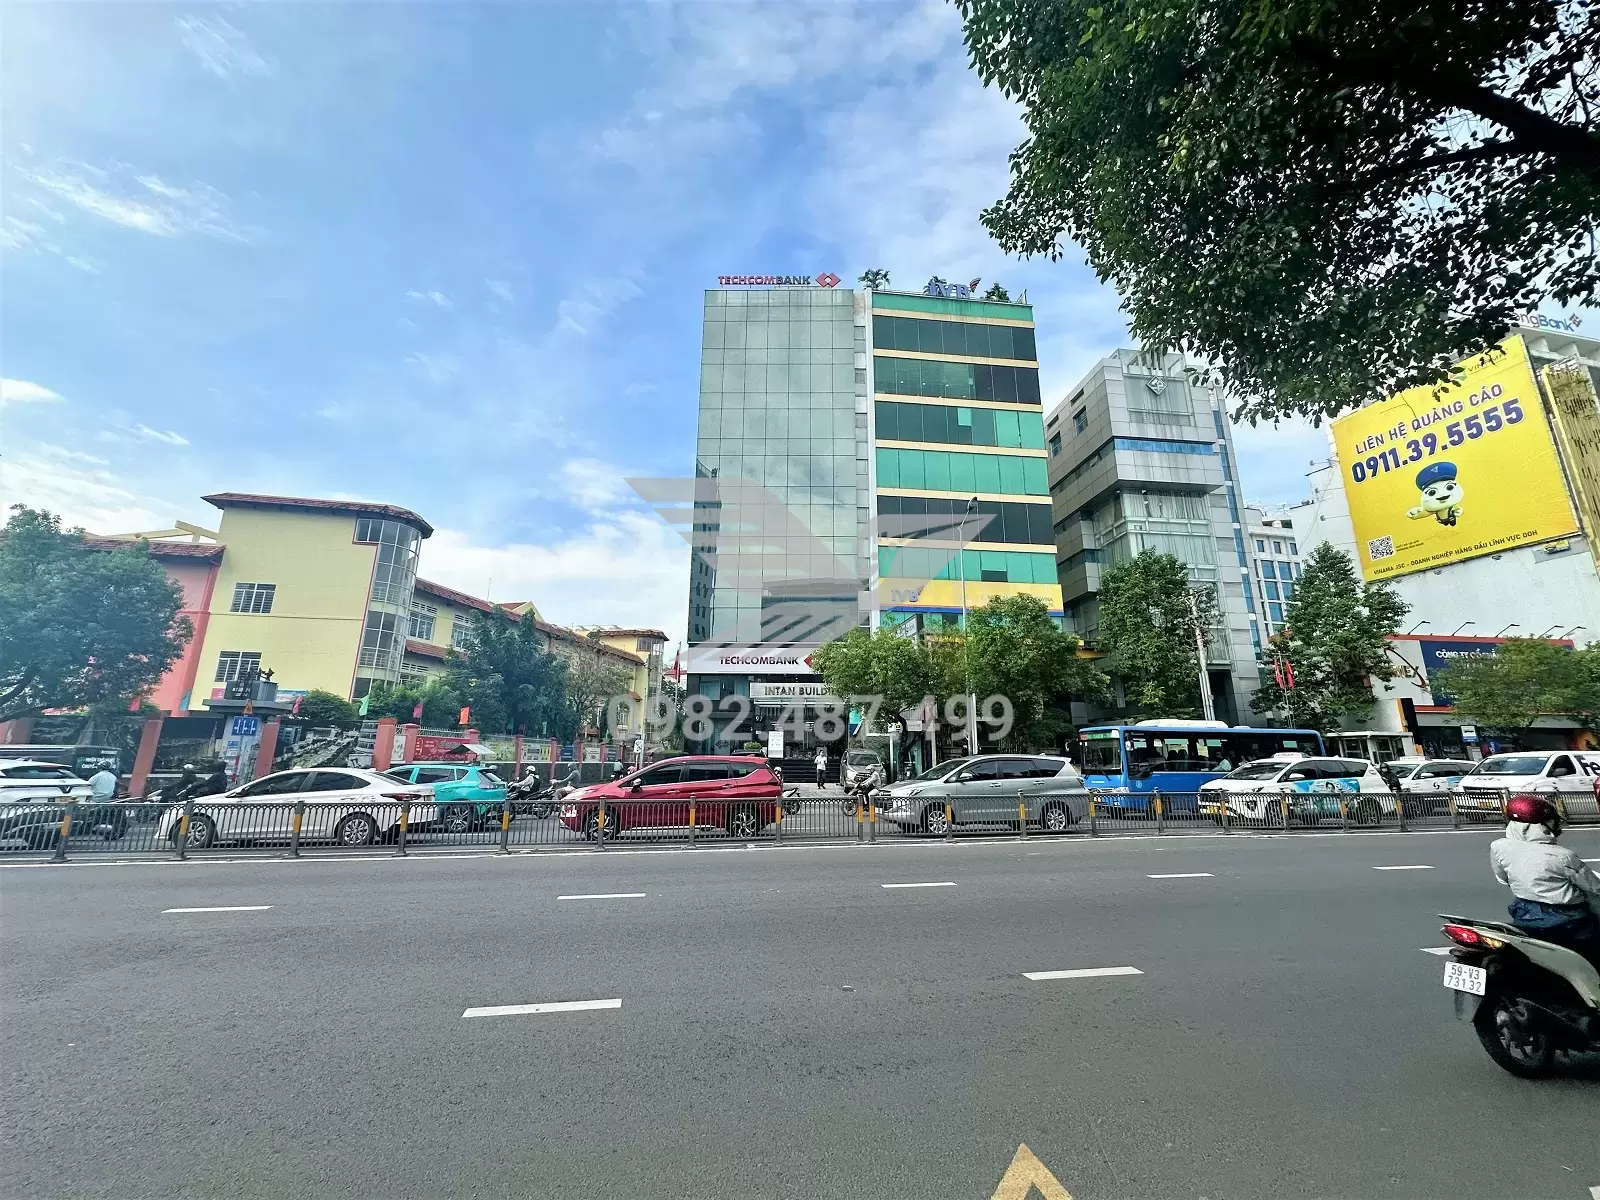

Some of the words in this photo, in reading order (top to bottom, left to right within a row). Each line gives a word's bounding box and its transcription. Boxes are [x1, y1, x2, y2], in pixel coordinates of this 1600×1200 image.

[718, 275, 811, 285] TECHCOMBANK
[1355, 434, 1385, 454] LIÊN
[1389, 422, 1408, 439] HỆ
[1411, 401, 1465, 432] QUẢNG
[1469, 384, 1503, 407] CÁO
[1351, 398, 1524, 483] 0911.39.5555
[1373, 565, 1394, 575] VINAMA
[1410, 557, 1431, 566] DOANH
[719, 656, 799, 665] TECHCOMBANK
[764, 686, 795, 695] INTAN
[1451, 964, 1480, 980] 59-V3
[1448, 974, 1482, 992] 731.32
